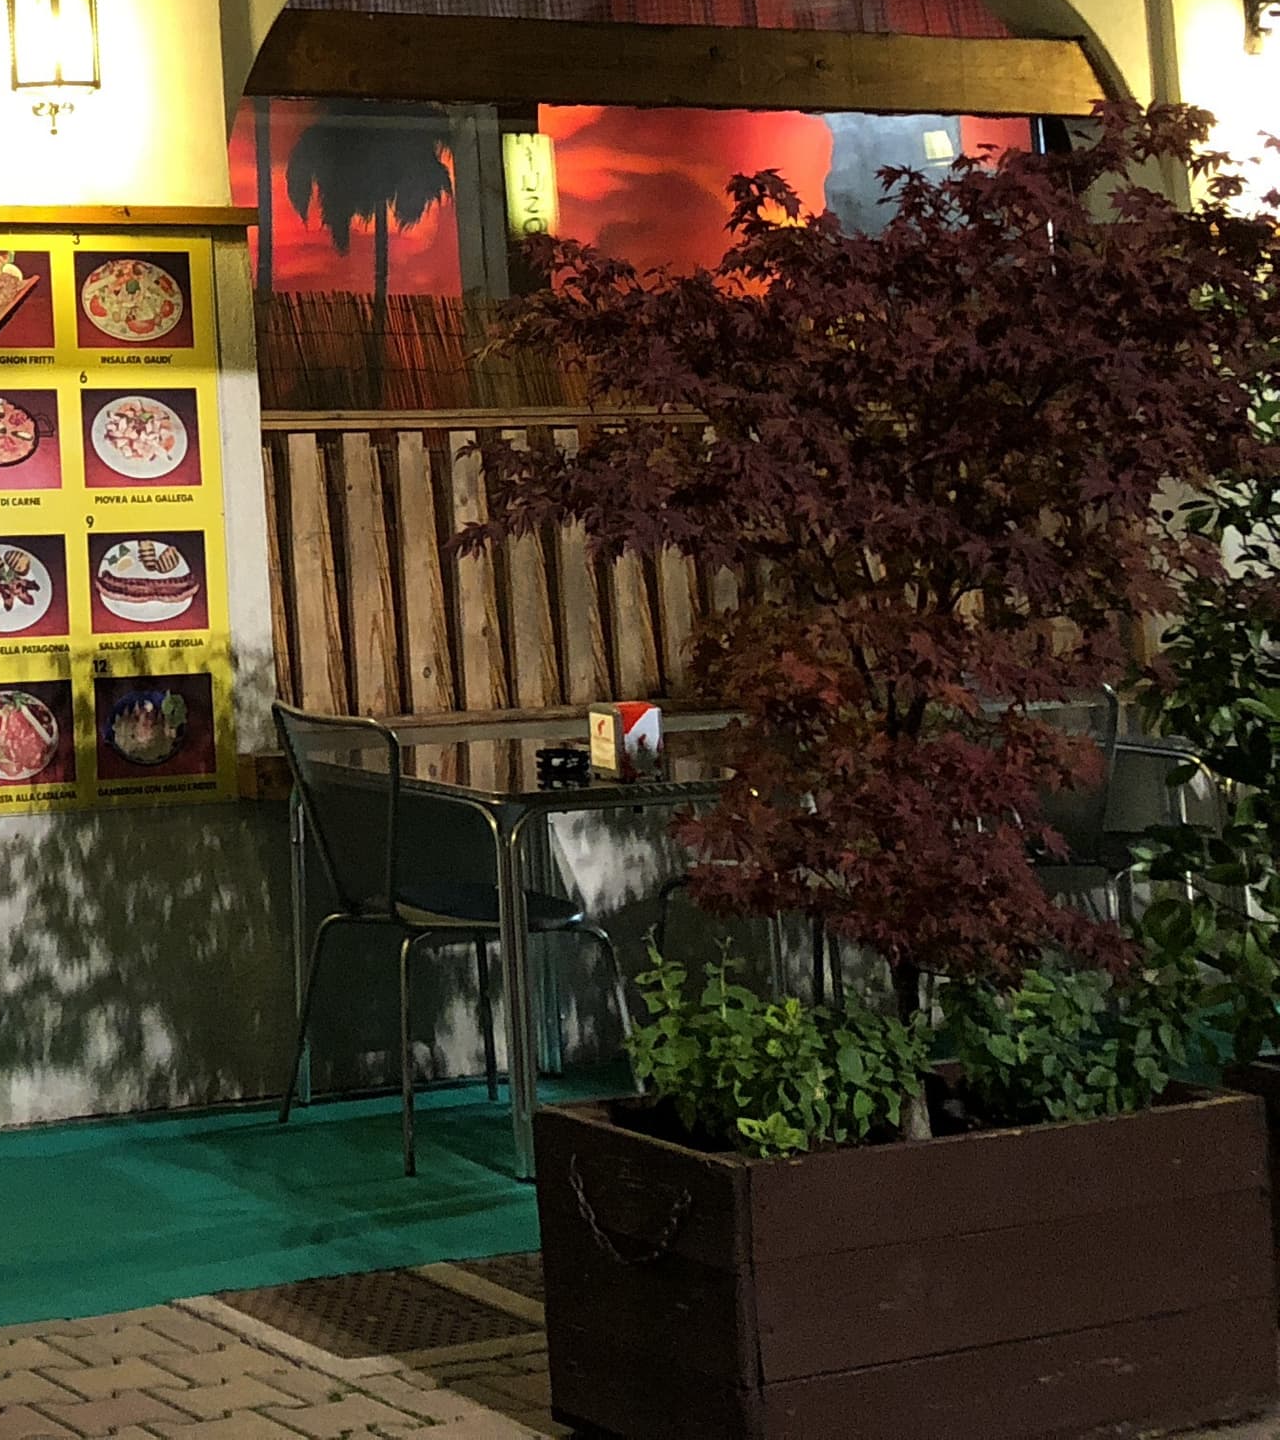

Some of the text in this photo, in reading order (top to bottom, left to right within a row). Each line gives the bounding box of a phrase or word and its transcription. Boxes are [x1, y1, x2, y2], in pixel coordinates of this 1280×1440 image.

[72, 233, 81, 245] 3
[27, 355, 55, 365] FRITTI
[101, 355, 142, 365] INSALATA
[79, 371, 88, 384] 6
[0, 496, 10, 507] DI
[11, 496, 41, 507] CARNE
[95, 493, 194, 504] PIOVRA ALLA GALLEGA
[85, 515, 94, 529] 9
[22, 643, 71, 655] PATAGONIA
[99, 638, 204, 651] SALSICCIA ALLA GRIGLIA
[93, 659, 108, 673] 12
[15, 793, 36, 804] ALLA
